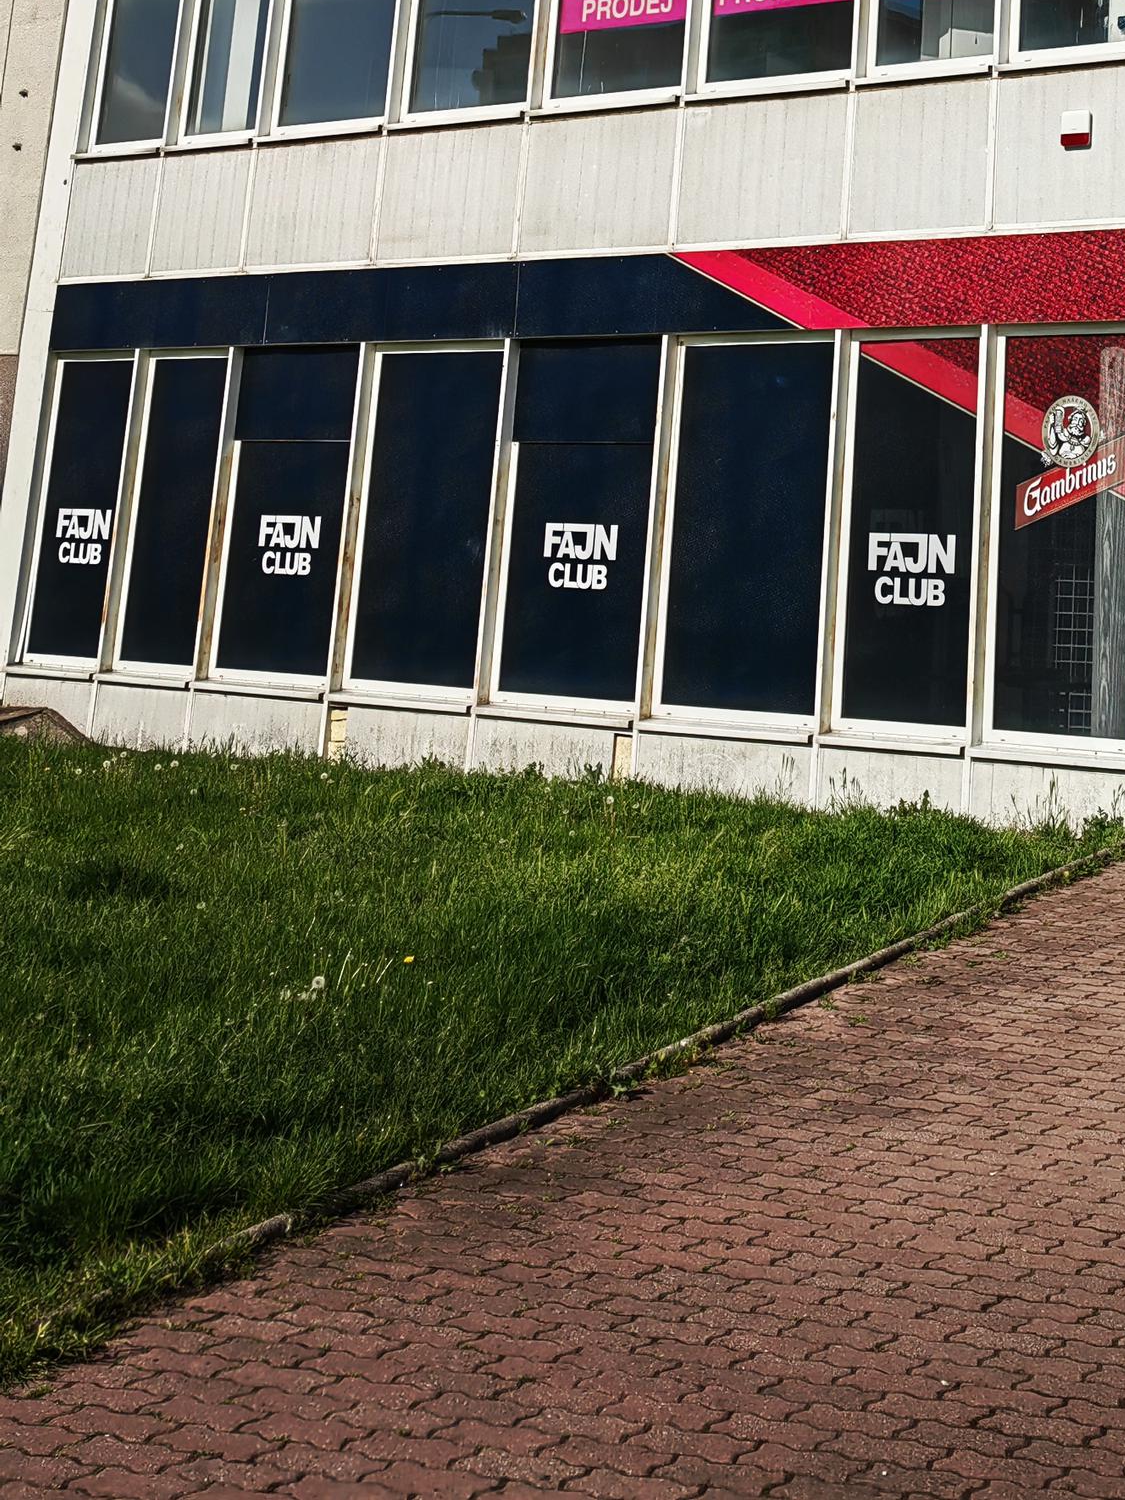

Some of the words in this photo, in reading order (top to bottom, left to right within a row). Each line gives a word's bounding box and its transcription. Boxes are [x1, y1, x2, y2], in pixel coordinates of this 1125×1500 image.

[1023, 454, 1117, 517] Gambrinus
[56, 508, 112, 540] FAJN
[259, 515, 321, 549] FAJN
[58, 543, 102, 565] CLUB
[543, 523, 618, 561] FAJN
[867, 533, 956, 575] FAJN
[262, 551, 311, 576] CLUB
[548, 563, 607, 590] CLUB
[874, 576, 946, 607] CLUB
